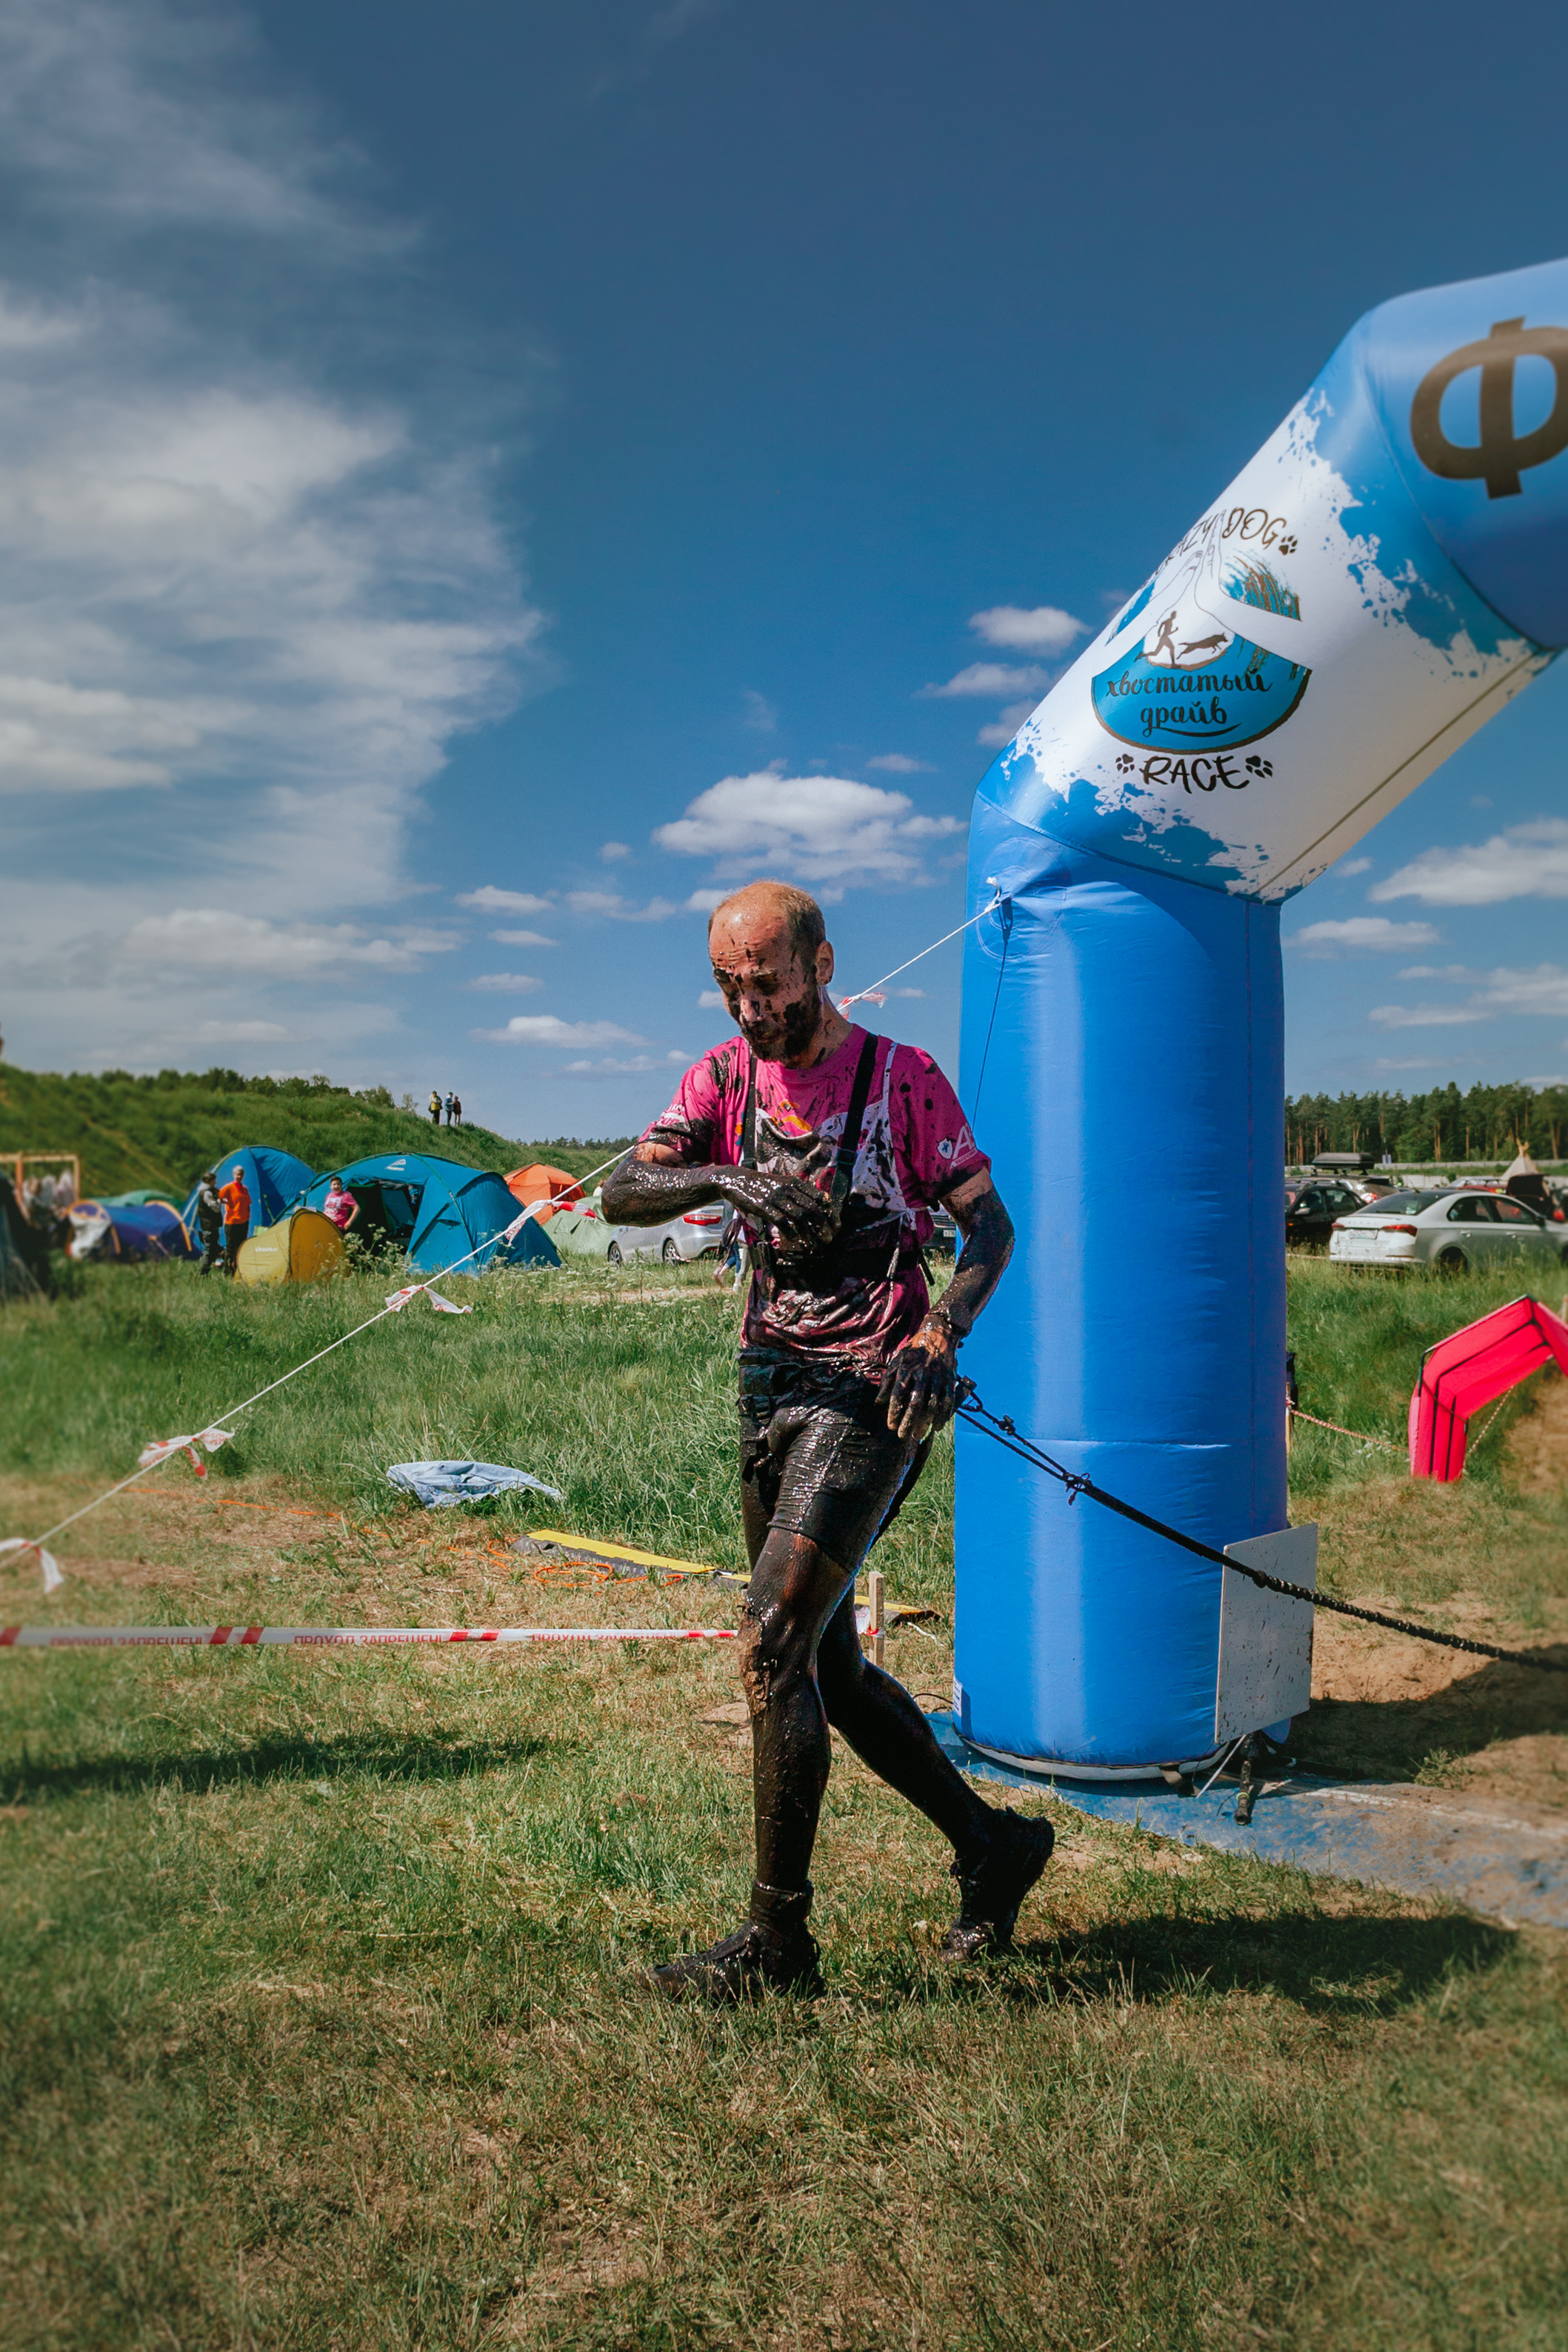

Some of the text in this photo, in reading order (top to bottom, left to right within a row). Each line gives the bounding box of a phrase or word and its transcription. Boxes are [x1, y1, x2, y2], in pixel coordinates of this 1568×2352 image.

[1221, 507, 1287, 550] DOG
[1105, 667, 1273, 698] хвостатый
[1140, 696, 1242, 737] драйв
[1139, 756, 1250, 794] RACE
